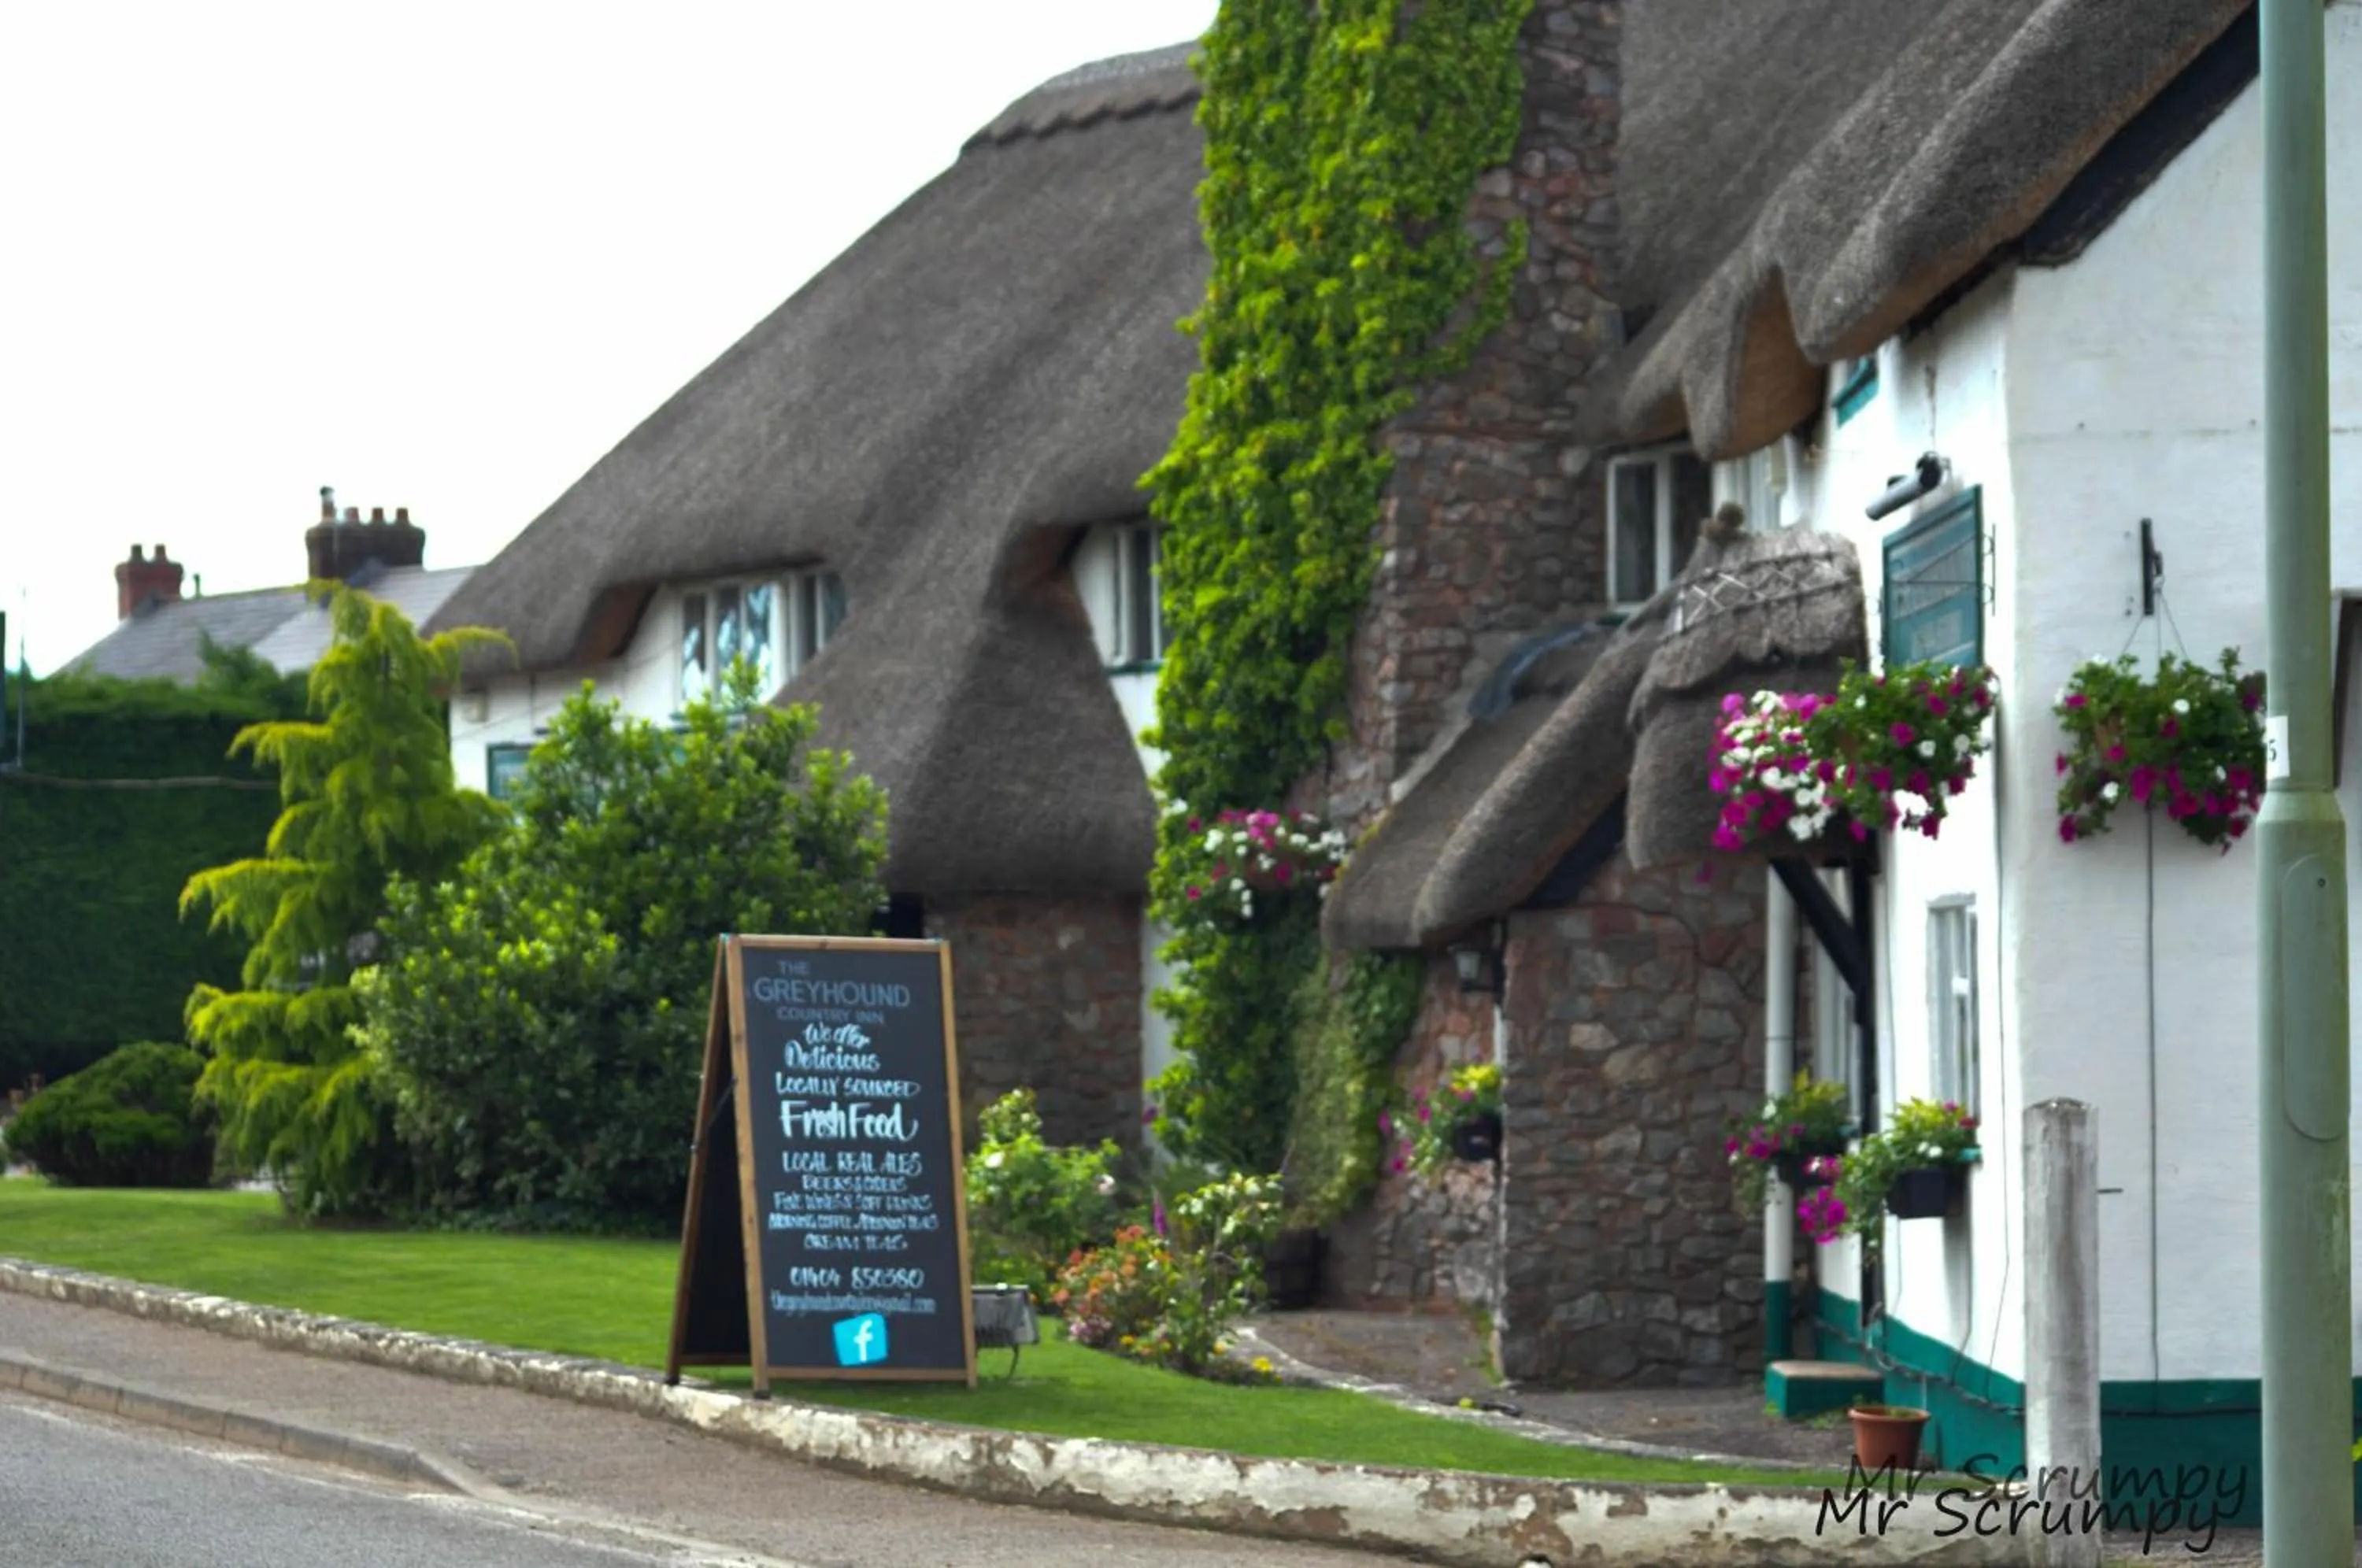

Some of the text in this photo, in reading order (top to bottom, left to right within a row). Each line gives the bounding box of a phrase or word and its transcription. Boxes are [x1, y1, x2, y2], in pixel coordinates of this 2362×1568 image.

[776, 960, 811, 975] THE
[753, 977, 910, 1008] GREYHOUND
[776, 1006, 853, 1023] COUNTRY
[803, 1021, 832, 1045] We
[784, 1039, 882, 1071] Delicious
[779, 1100, 919, 1141] Fresh Food
[782, 1151, 922, 1176] LOCAL REAL ALES
[790, 1266, 841, 1288] 01404
